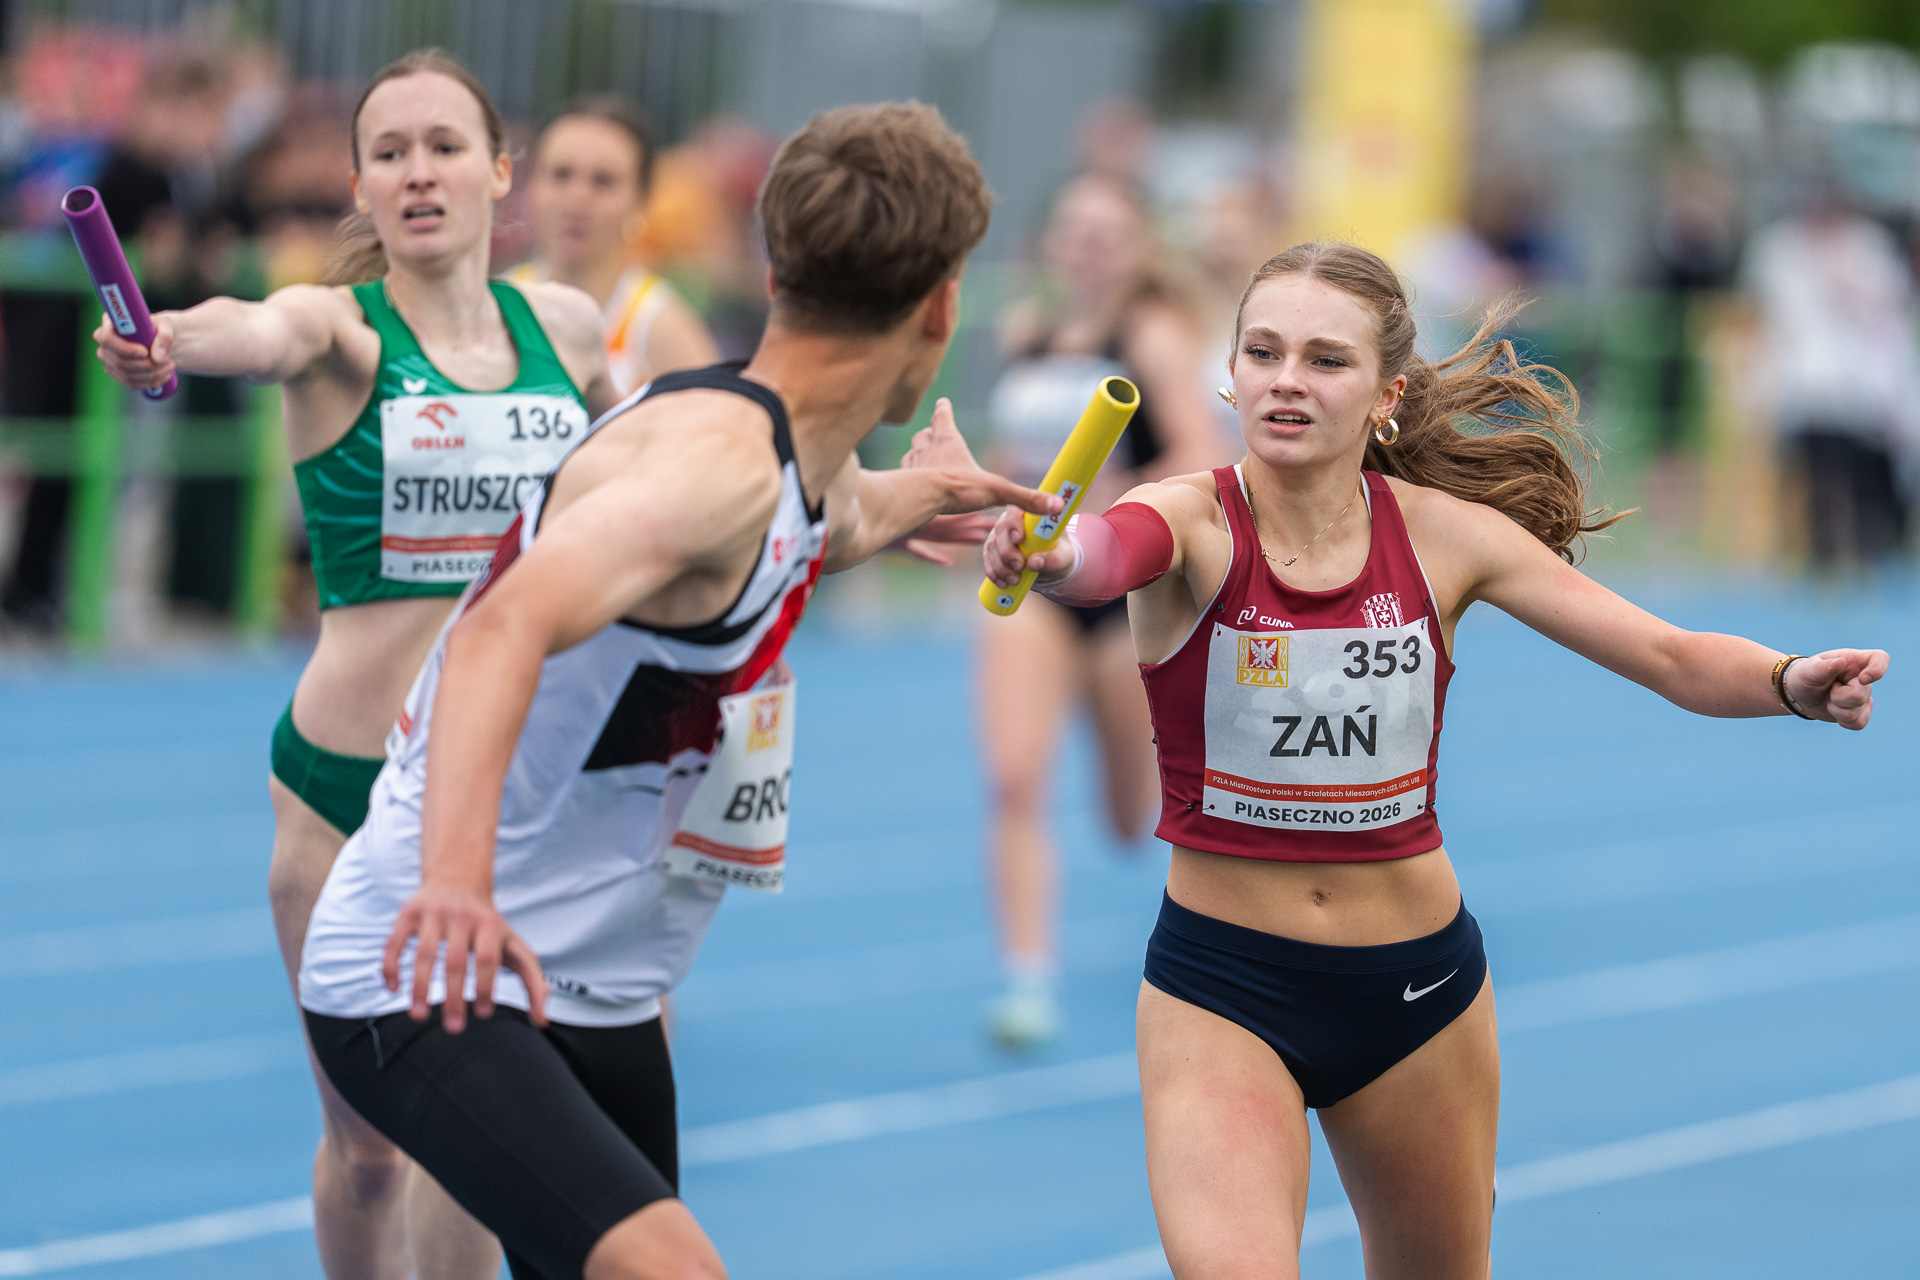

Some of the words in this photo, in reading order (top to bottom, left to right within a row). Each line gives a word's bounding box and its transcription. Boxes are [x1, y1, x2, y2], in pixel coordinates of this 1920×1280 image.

[507, 406, 573, 441] 136
[411, 435, 466, 450] ORLEN
[1259, 615, 1294, 629] CUNA
[1342, 635, 1421, 679] 353
[1239, 669, 1285, 685] PZLA
[1269, 704, 1377, 757] ZAŃ
[1212, 775, 1229, 786] PZLA
[1229, 781, 1271, 795] Mistrzostwa
[1272, 788, 1294, 796] Polski
[1345, 787, 1386, 797] Mieszanych
[1410, 775, 1420, 785] U18
[1235, 801, 1354, 824] PIASECZNO
[1359, 802, 1401, 823] 2026
